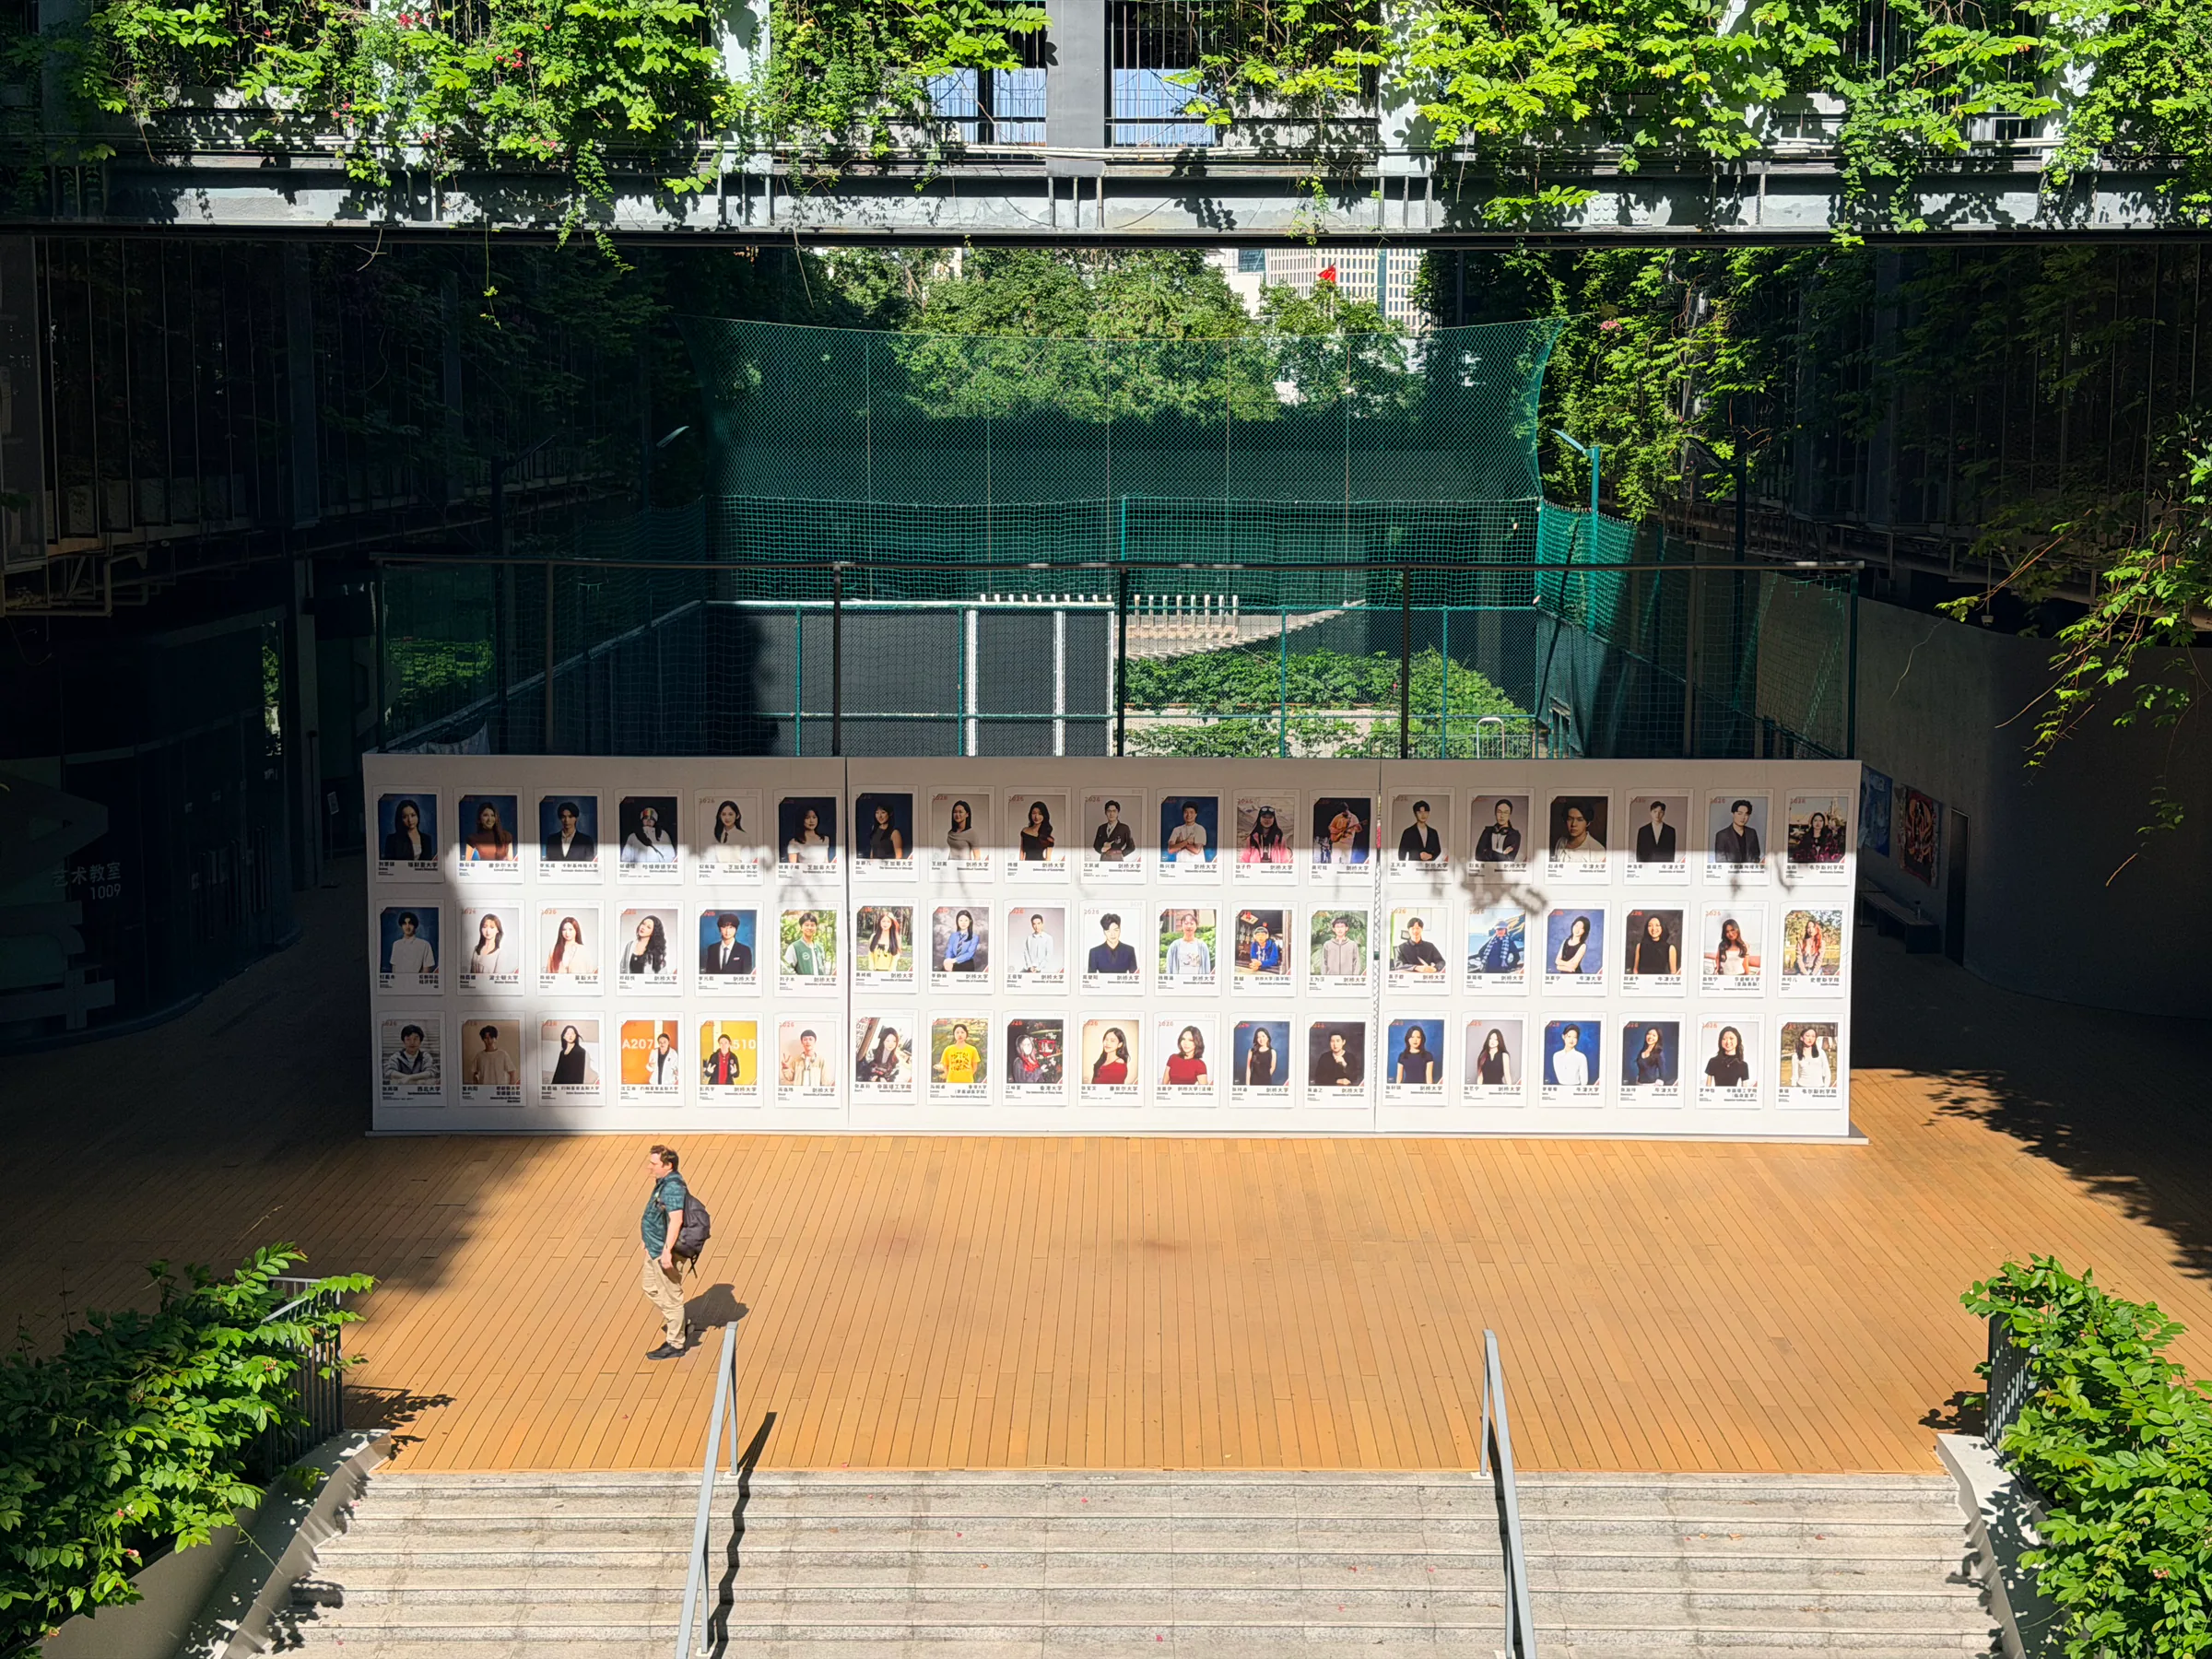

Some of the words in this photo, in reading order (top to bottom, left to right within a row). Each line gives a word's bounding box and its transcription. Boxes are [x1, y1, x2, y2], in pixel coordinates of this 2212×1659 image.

[52, 862, 122, 888] 艺术教室
[90, 883, 122, 900] 1009
[622, 1039, 654, 1050] A207
